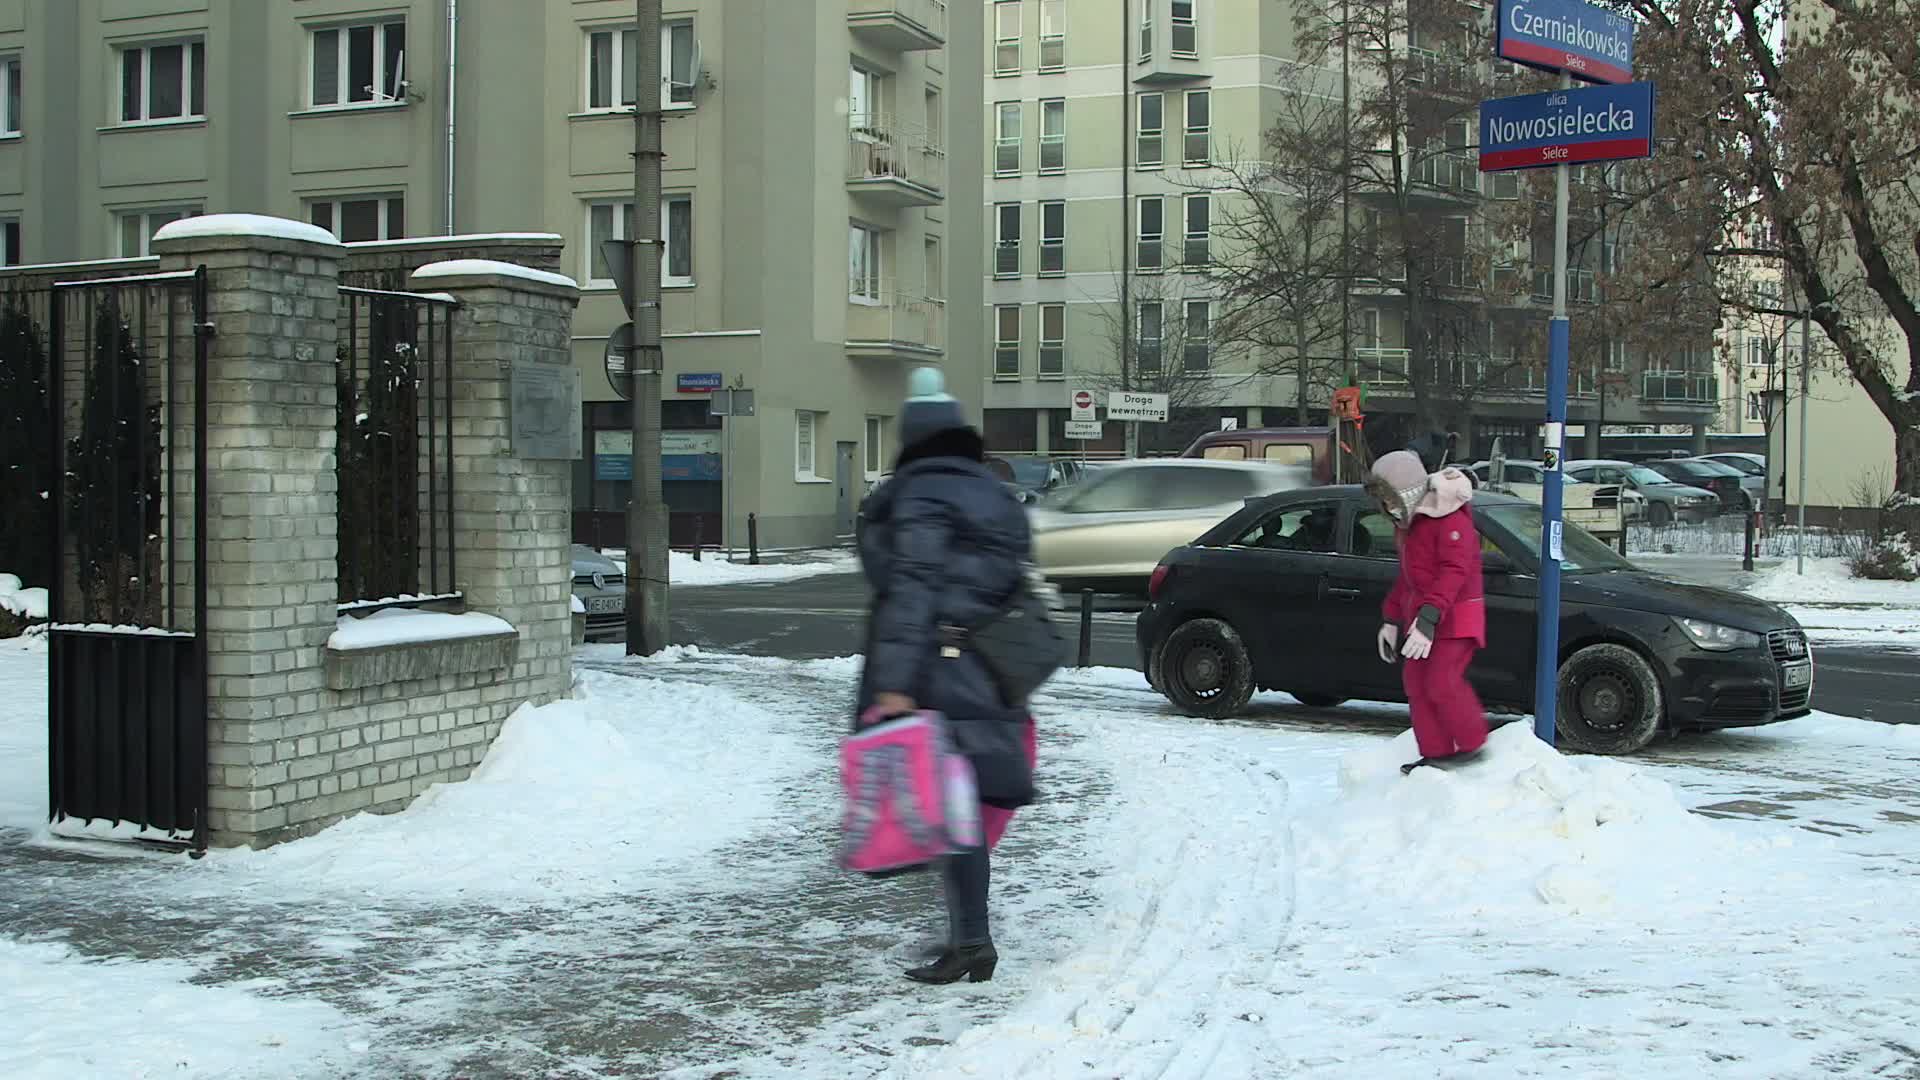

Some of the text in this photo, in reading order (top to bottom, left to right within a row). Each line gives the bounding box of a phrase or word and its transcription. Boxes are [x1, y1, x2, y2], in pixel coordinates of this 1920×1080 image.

[1510, 4, 1628, 63] Czerniakowska
[1565, 54, 1586, 70] Sielce
[1546, 94, 1568, 106] ulica
[1489, 102, 1634, 145] Nowosielecka
[1542, 147, 1568, 160] Sielce
[1124, 394, 1153, 405] Droga
